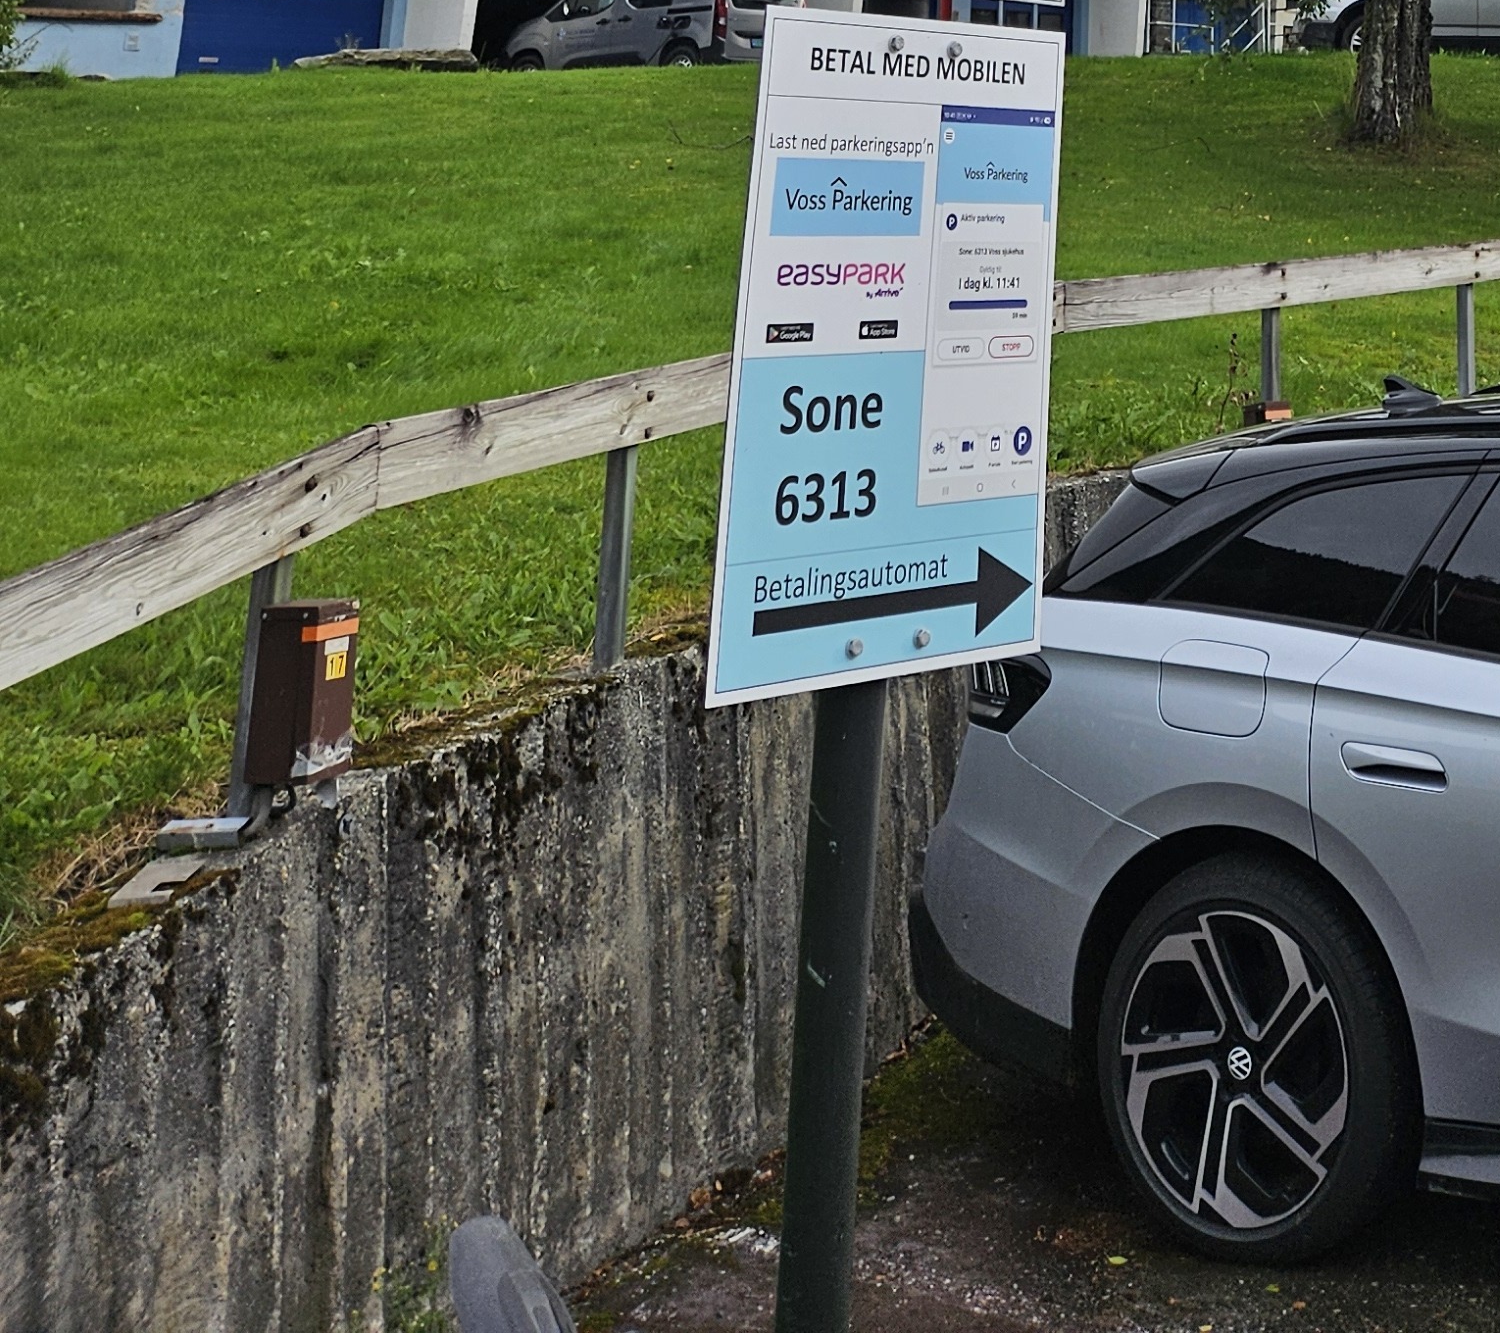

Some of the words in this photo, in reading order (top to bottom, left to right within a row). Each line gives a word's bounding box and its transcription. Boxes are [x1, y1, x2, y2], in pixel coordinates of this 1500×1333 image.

[811, 47, 876, 75] BETAL
[883, 53, 930, 78] MED
[937, 57, 1026, 85] MOBILEN
[769, 133, 797, 150] Last
[801, 134, 828, 150] ned
[964, 167, 985, 180] Voss
[987, 168, 1028, 183] Parkering
[785, 188, 826, 211] Voss
[832, 189, 913, 216] Parkering
[963, 277, 980, 292] dag
[982, 277, 993, 289] kl.
[996, 277, 1020, 290] 11:41
[780, 385, 883, 435] Sone
[775, 469, 877, 526] 6313
[754, 554, 949, 604] Betalingsautomat
[328, 654, 345, 677] 17
